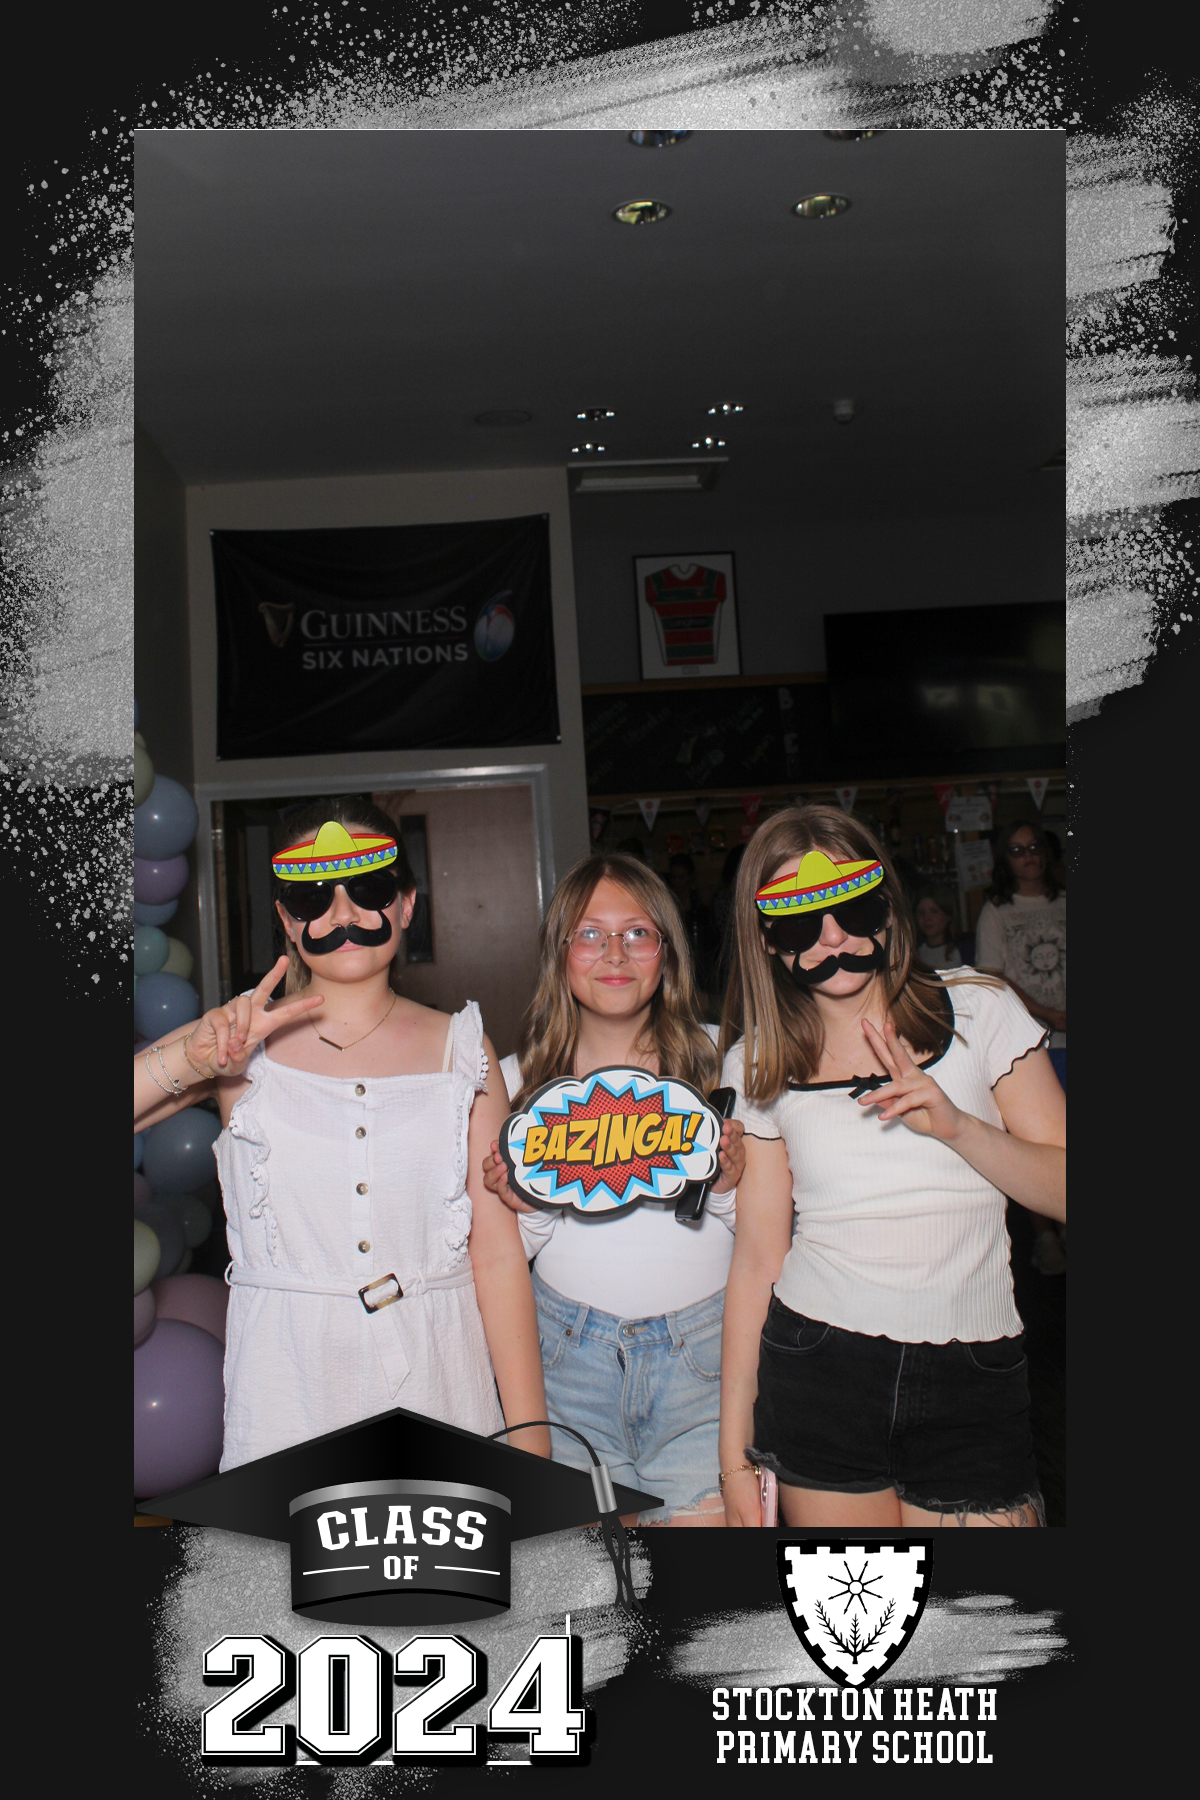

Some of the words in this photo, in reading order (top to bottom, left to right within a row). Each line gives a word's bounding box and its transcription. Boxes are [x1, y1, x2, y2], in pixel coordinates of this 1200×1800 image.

[301, 606, 467, 640] GUINNESS
[302, 648, 343, 670] SIX
[352, 643, 468, 668] NATIONS
[523, 1112, 703, 1169] BAZINGA!
